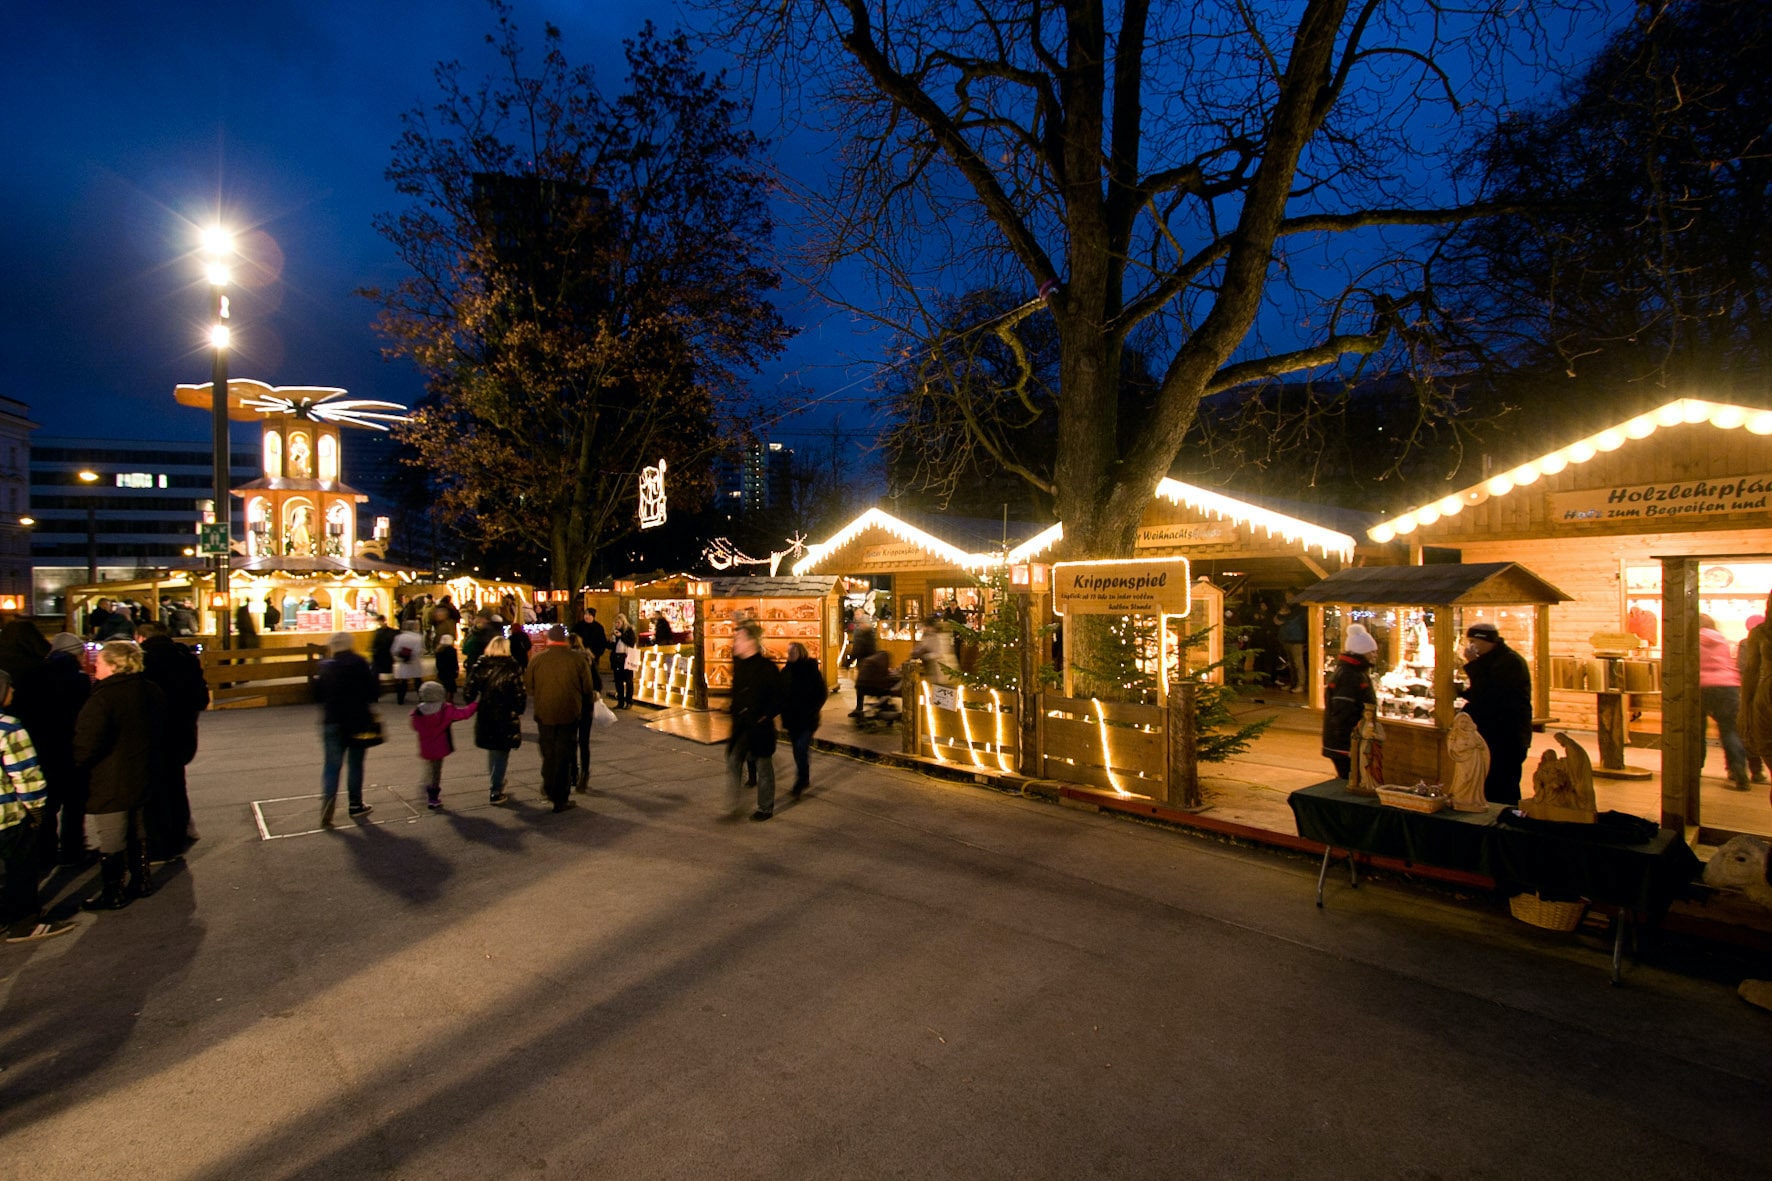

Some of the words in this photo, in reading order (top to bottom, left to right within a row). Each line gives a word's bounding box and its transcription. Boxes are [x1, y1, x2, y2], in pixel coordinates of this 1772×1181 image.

[1607, 508, 1640, 518] zum
[1645, 501, 1725, 517] Begreifen
[1731, 496, 1767, 510] und
[1073, 572, 1167, 591] Krippenspiel
